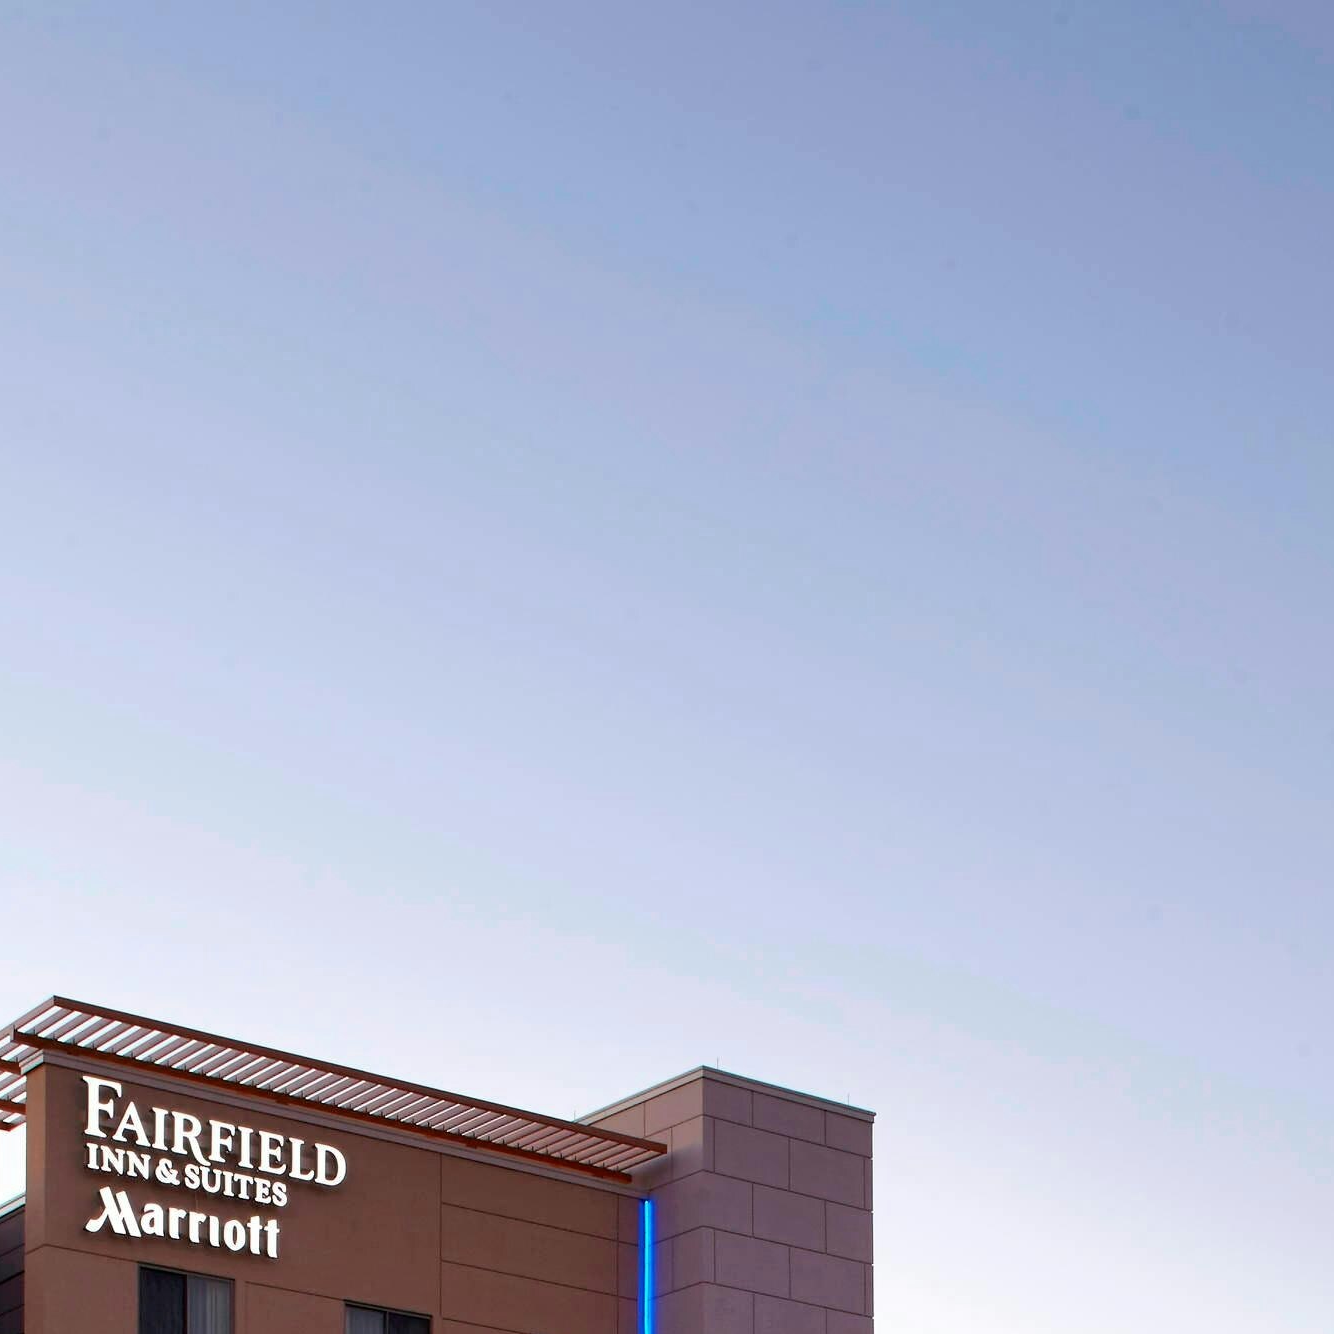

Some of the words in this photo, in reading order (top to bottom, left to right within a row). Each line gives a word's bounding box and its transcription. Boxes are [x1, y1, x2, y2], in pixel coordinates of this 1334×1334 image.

[82, 1076, 347, 1187] FAIRFIELD
[86, 1143, 151, 1180] INN
[155, 1158, 180, 1186] &
[184, 1163, 288, 1207] SUITES
[85, 1186, 280, 1259] Marriott
